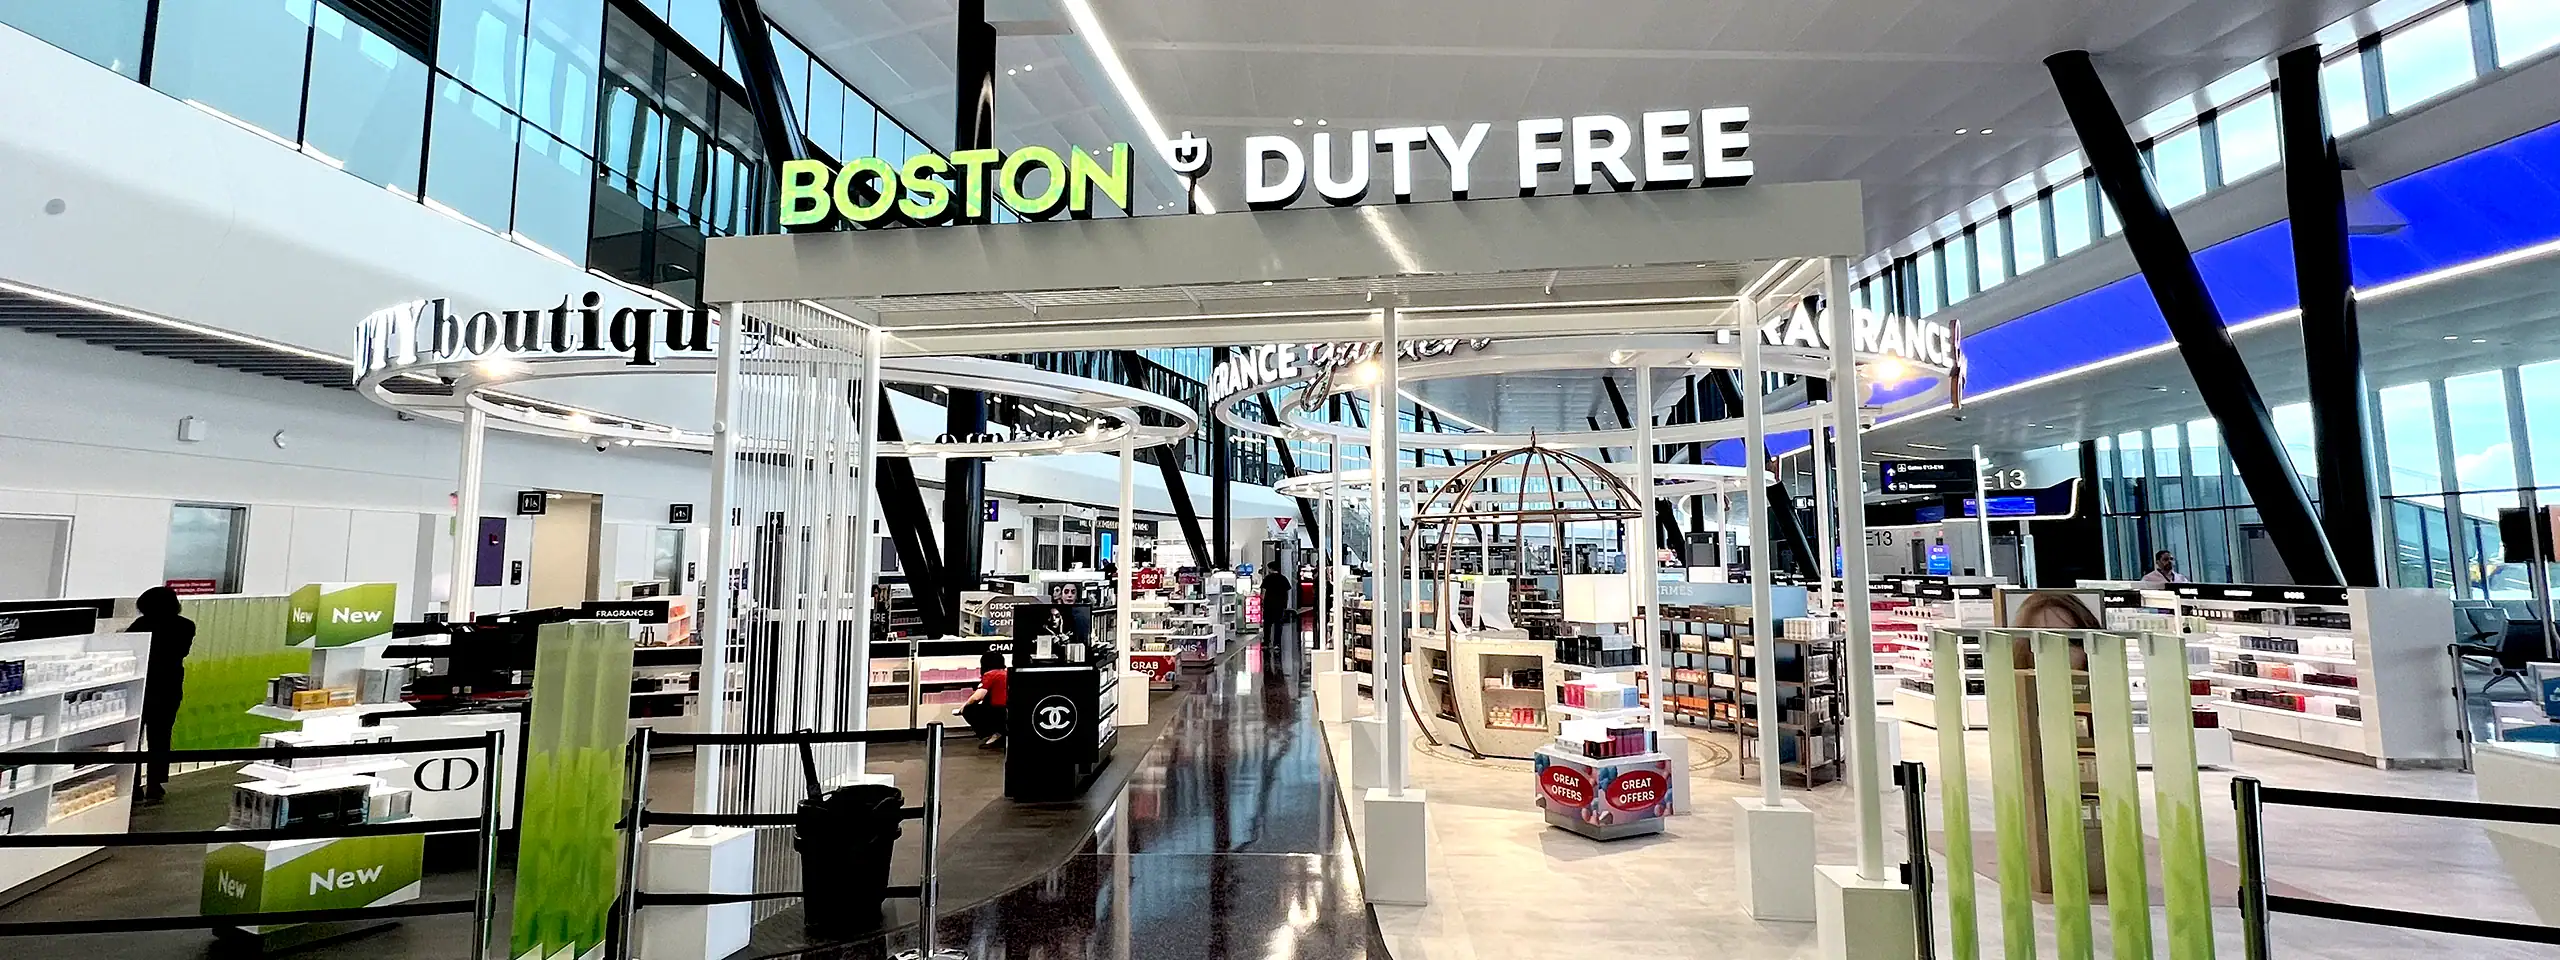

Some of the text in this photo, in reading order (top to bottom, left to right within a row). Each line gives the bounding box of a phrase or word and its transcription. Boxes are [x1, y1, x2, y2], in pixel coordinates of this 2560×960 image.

[780, 107, 1754, 226] BOSTON DUTY FREE
[353, 298, 428, 385] UTY
[292, 606, 314, 624] New
[331, 606, 383, 625] New
[595, 608, 655, 618] FRAGRANCES
[989, 610, 1012, 618] YOUR
[1131, 661, 1159, 670] GRAB
[1553, 772, 1580, 788] GREAT
[1621, 777, 1652, 791] GREAT
[1551, 784, 1583, 802] OFFERS
[1619, 790, 1655, 804] OFFERS
[218, 868, 247, 899] New
[309, 864, 384, 896] New
